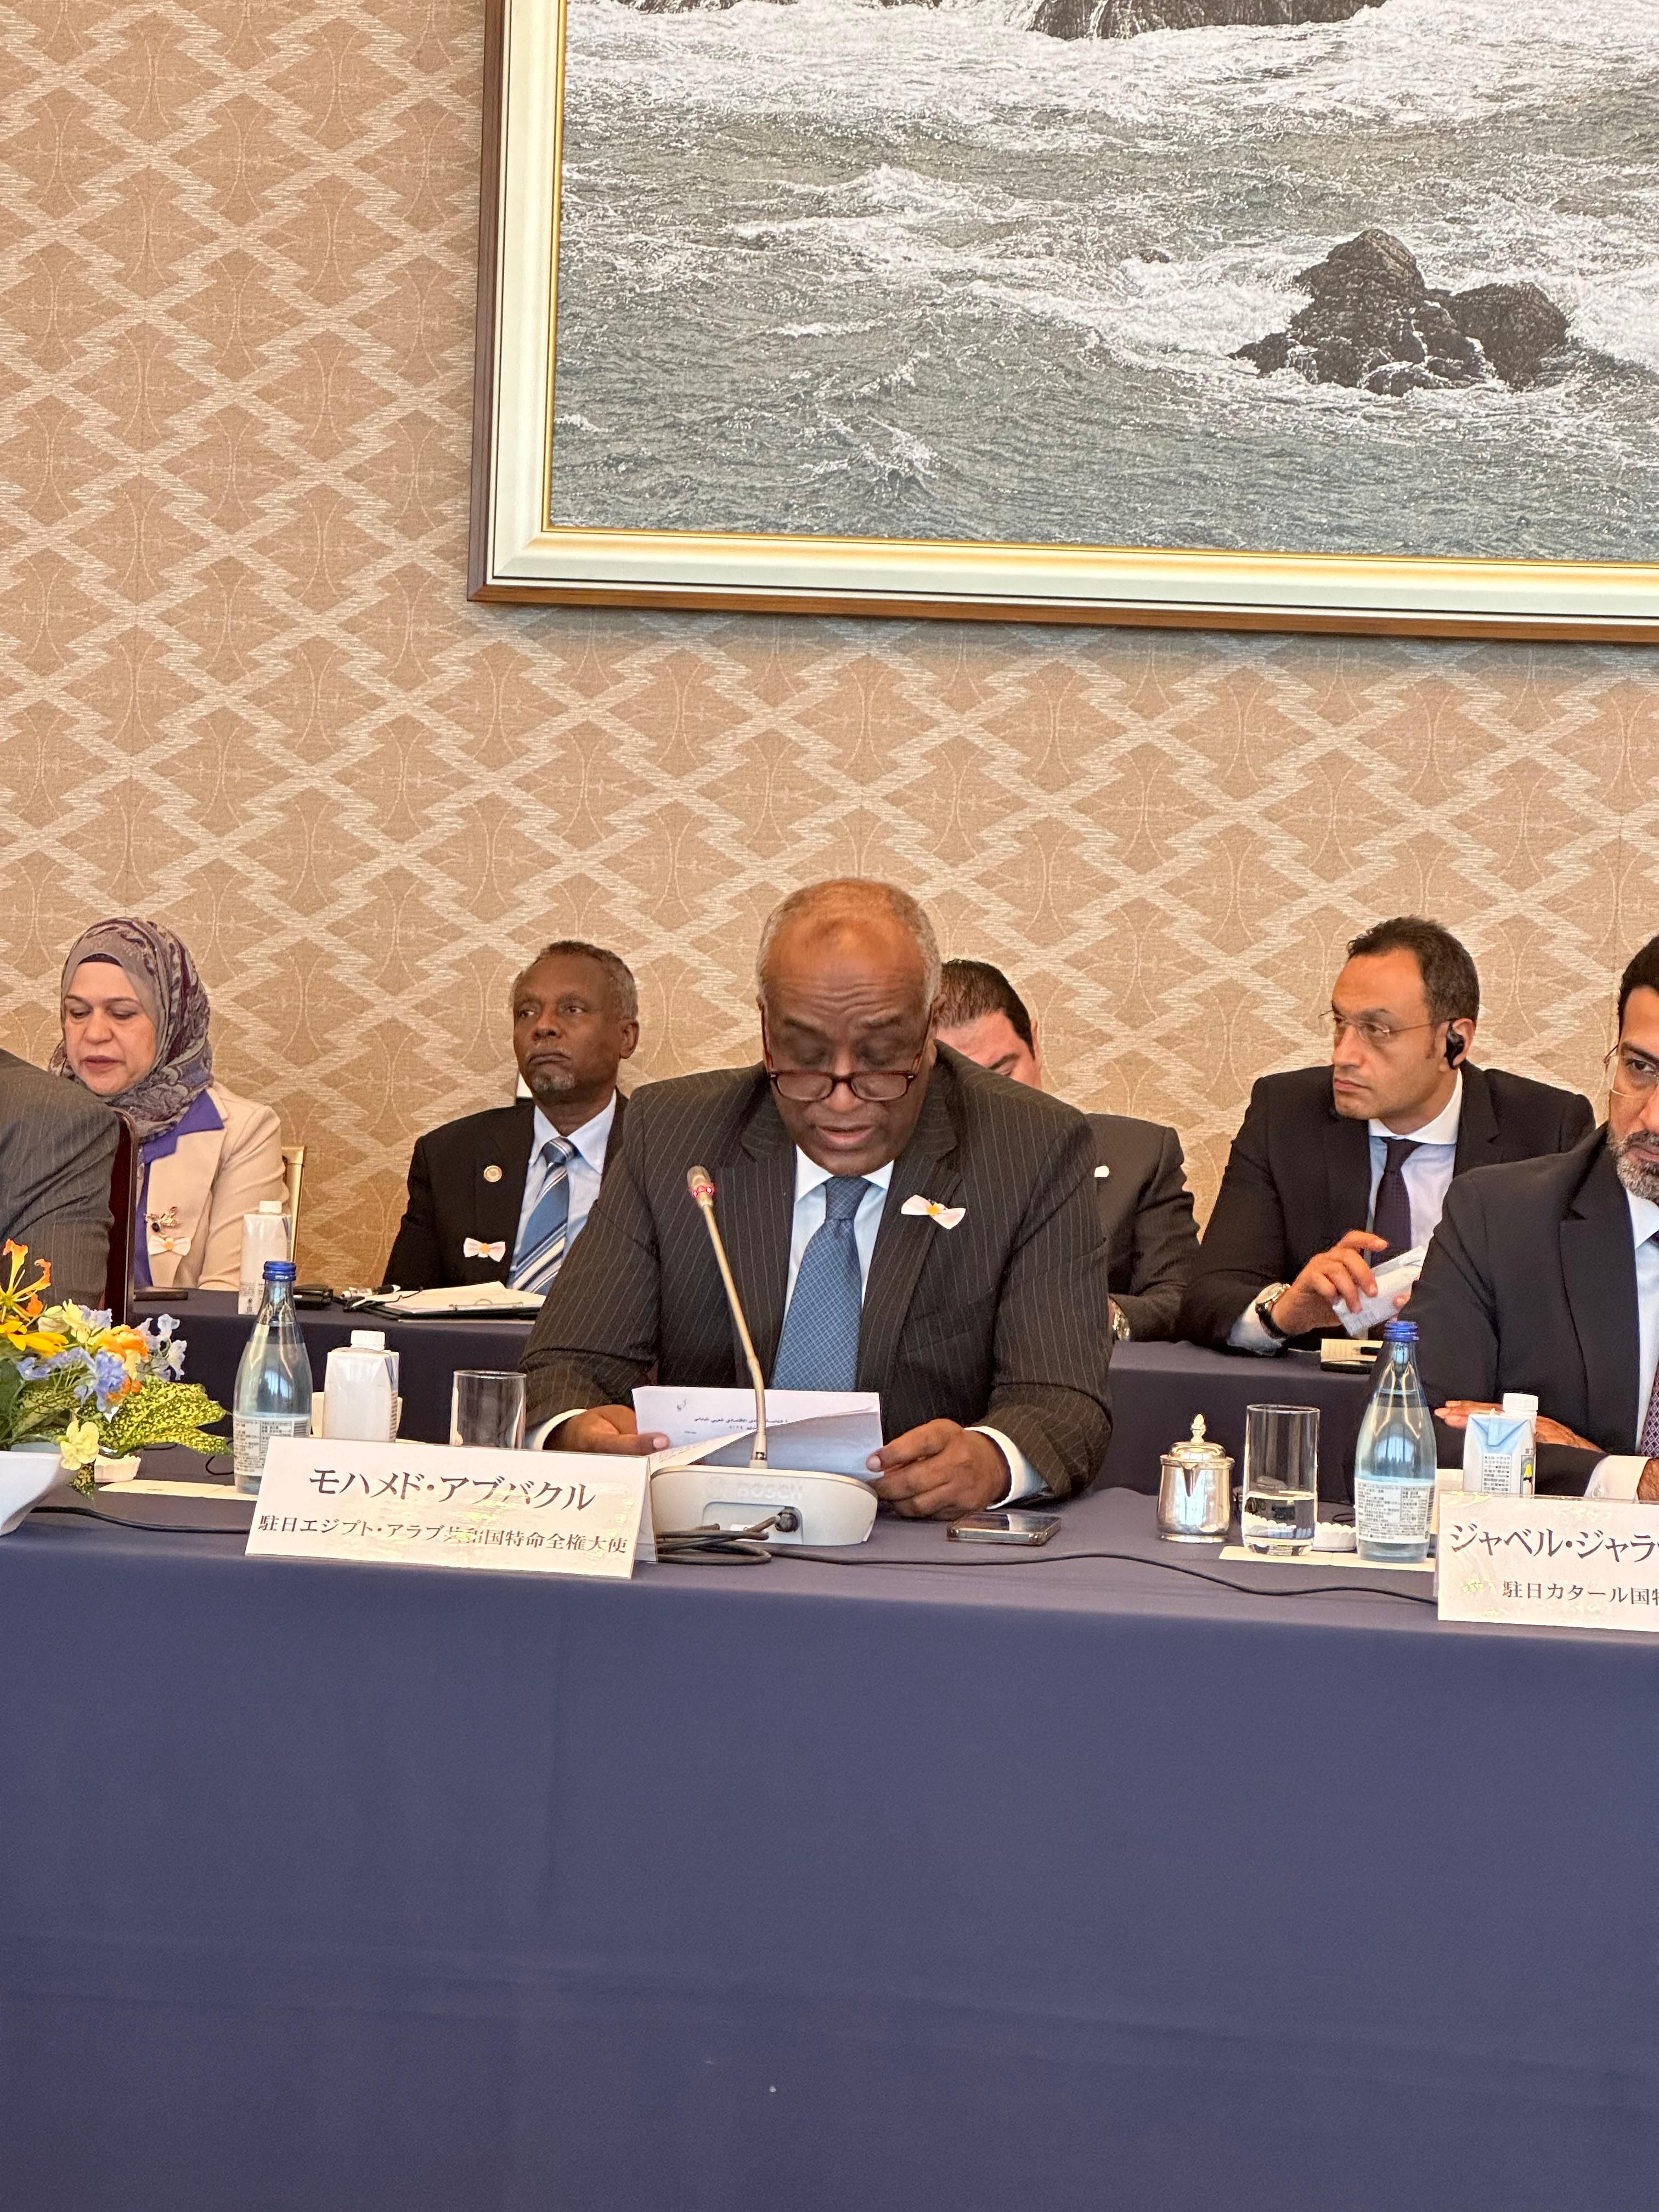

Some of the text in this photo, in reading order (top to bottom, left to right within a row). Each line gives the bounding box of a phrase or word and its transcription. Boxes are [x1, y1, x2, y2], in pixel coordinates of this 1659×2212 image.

[309, 1469, 596, 1511] モハメド・アブバクル
[1450, 1523, 1659, 1562] ジャベル・ジャラ
